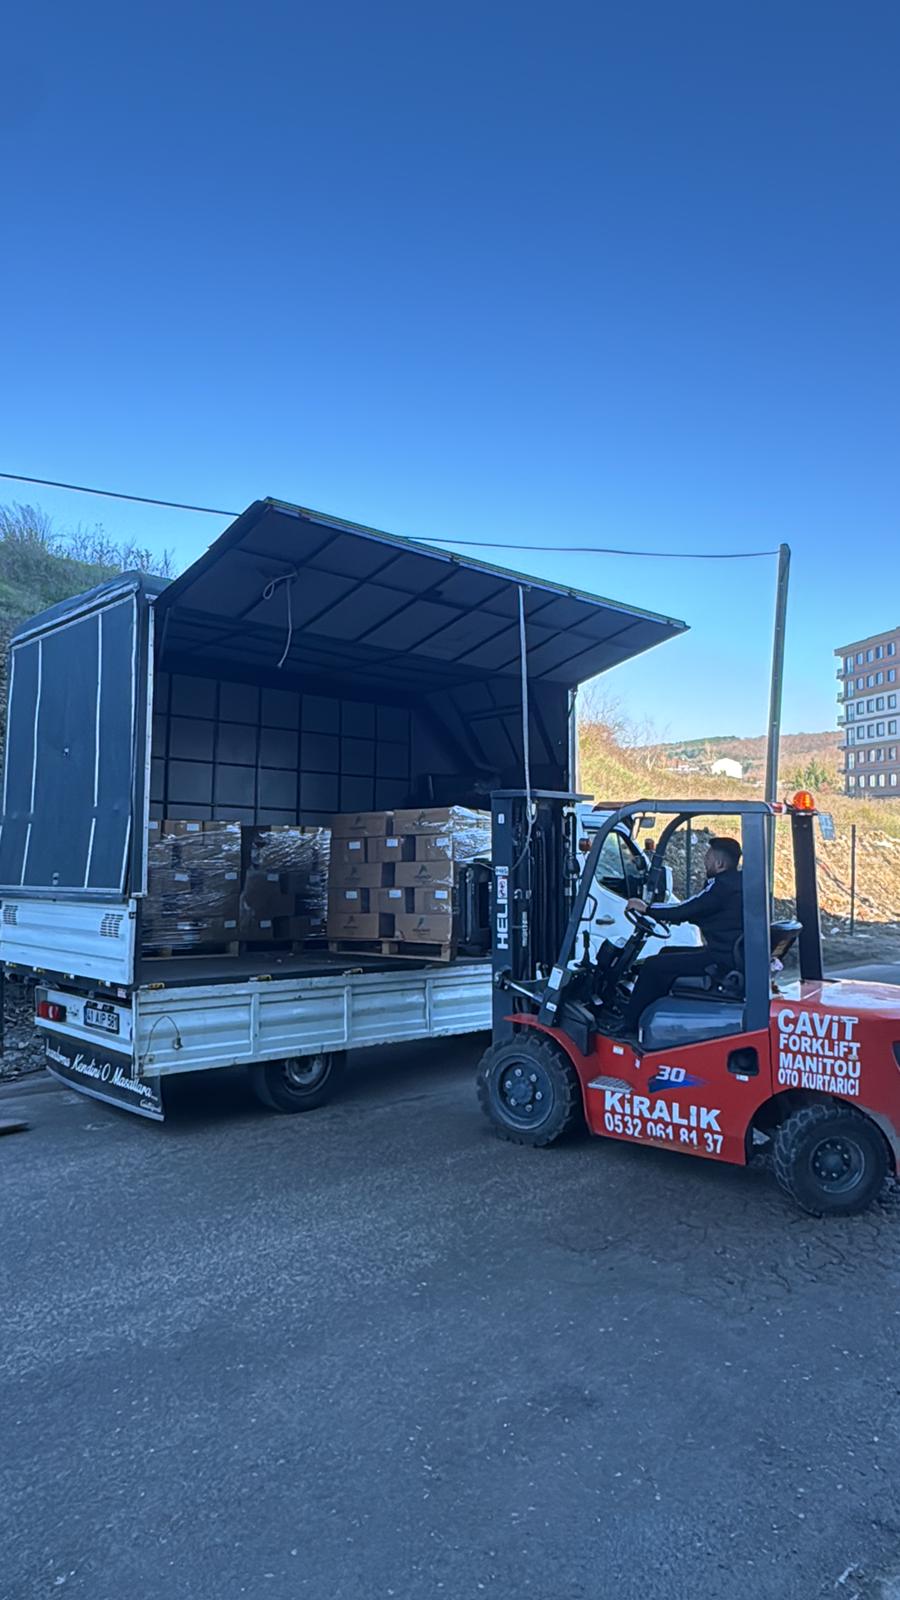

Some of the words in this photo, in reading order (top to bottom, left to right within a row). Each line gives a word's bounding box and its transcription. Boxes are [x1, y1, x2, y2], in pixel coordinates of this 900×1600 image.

[656, 1065, 686, 1083] 30
[778, 1068, 799, 1087] OTO
[604, 1112, 643, 1138] 0532
[646, 1121, 674, 1140] 061
[679, 1127, 698, 1147] 81
[704, 1132, 724, 1154] 37
